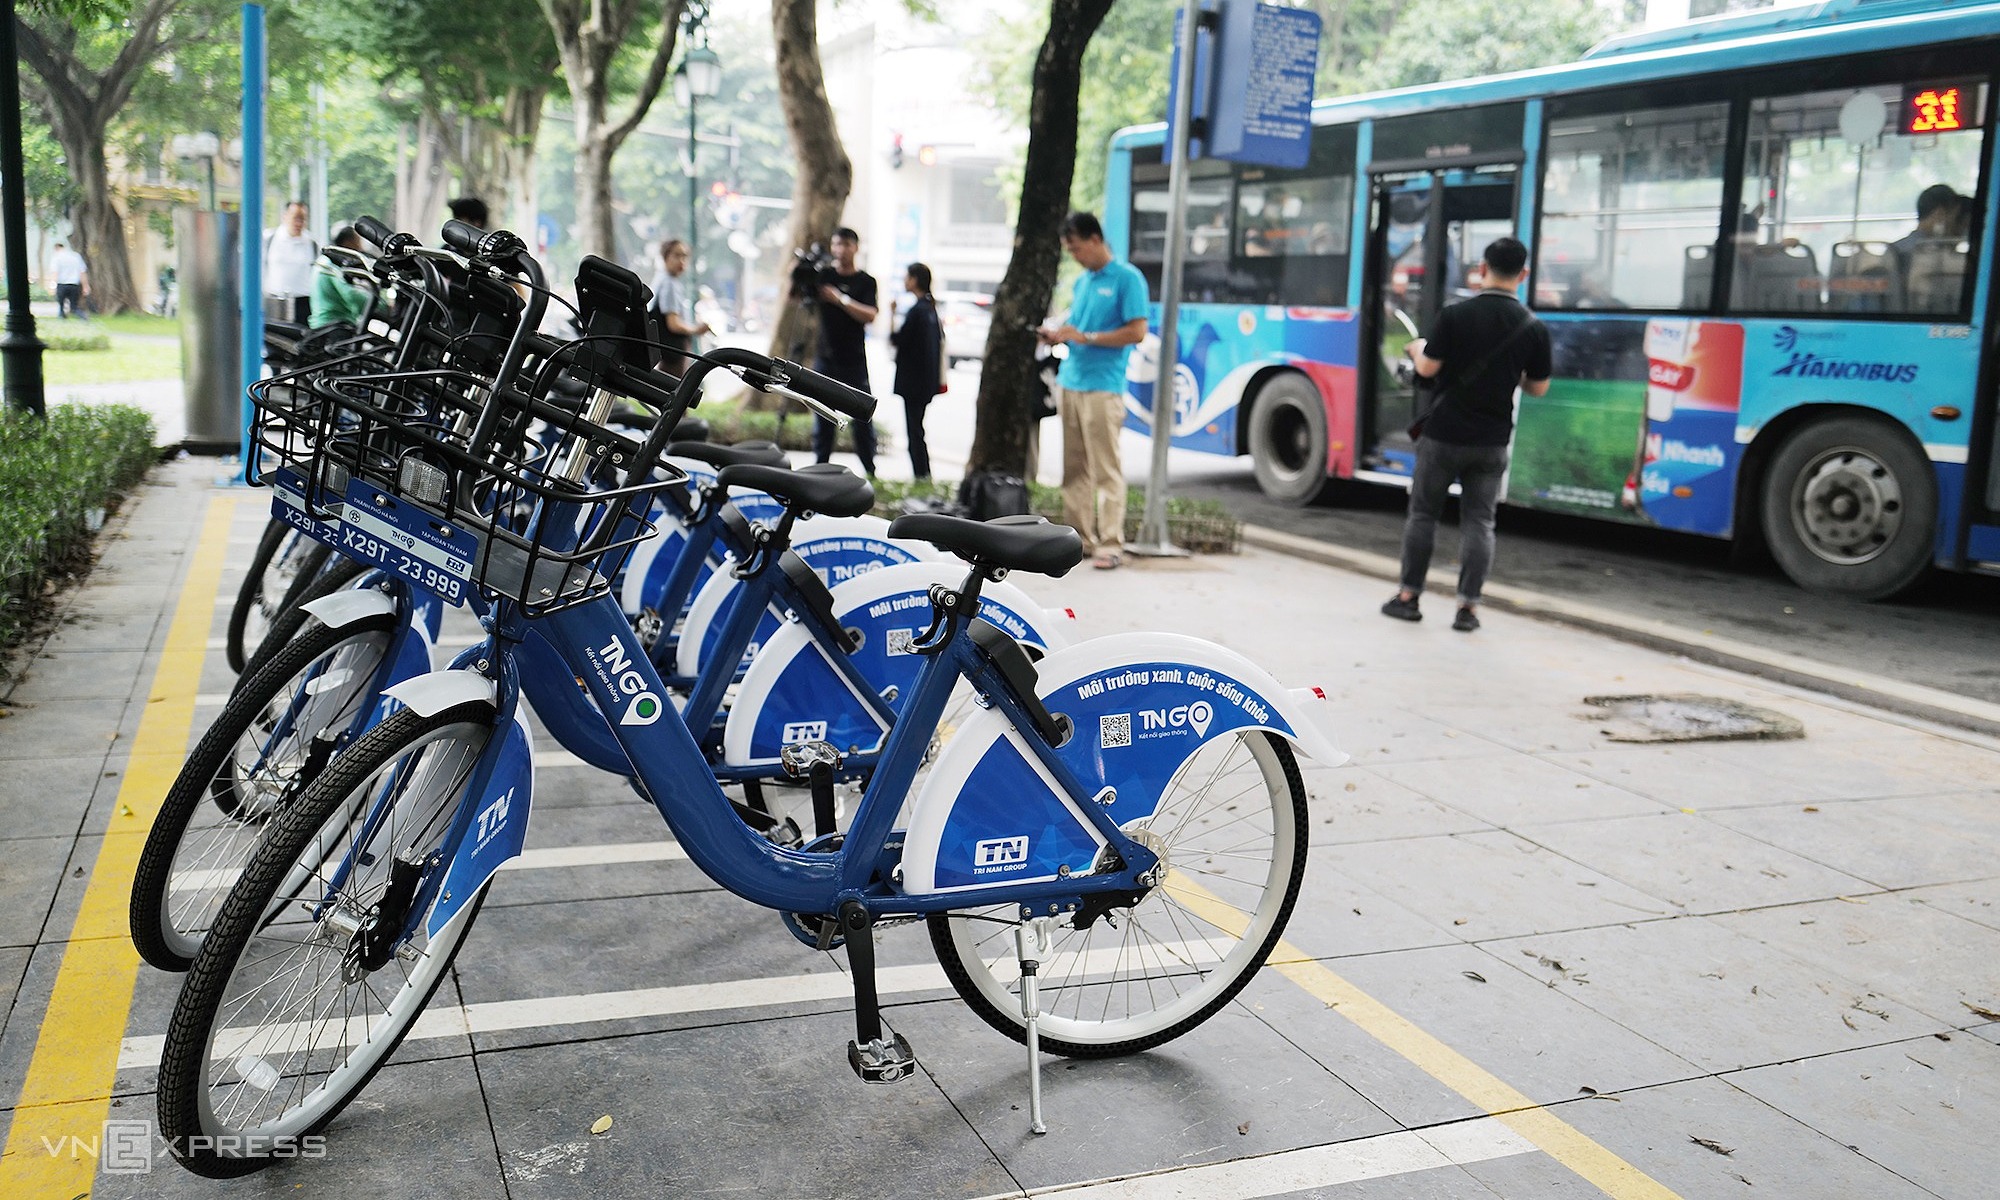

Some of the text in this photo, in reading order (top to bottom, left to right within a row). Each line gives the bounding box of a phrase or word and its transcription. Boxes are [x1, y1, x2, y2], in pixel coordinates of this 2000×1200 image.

[1911, 88, 1960, 132] 31
[1773, 352, 1919, 384] HANOIBUS
[868, 603, 892, 619] Môi
[891, 594, 929, 612] trường
[982, 603, 1006, 624] sống
[584, 646, 621, 703] Kết nối giao thông
[1077, 678, 1105, 700] Môi
[1105, 670, 1149, 691] trường
[1186, 671, 1216, 691] Cuộc
[1215, 681, 1245, 706] sống
[1241, 696, 1270, 725] khỏe
[789, 725, 821, 740] TN
[1158, 731, 1171, 739] giao
[477, 786, 515, 843] TN
[982, 840, 1022, 862] TN
[986, 865, 1003, 874] NAM
[1003, 863, 1028, 872] GROUP
